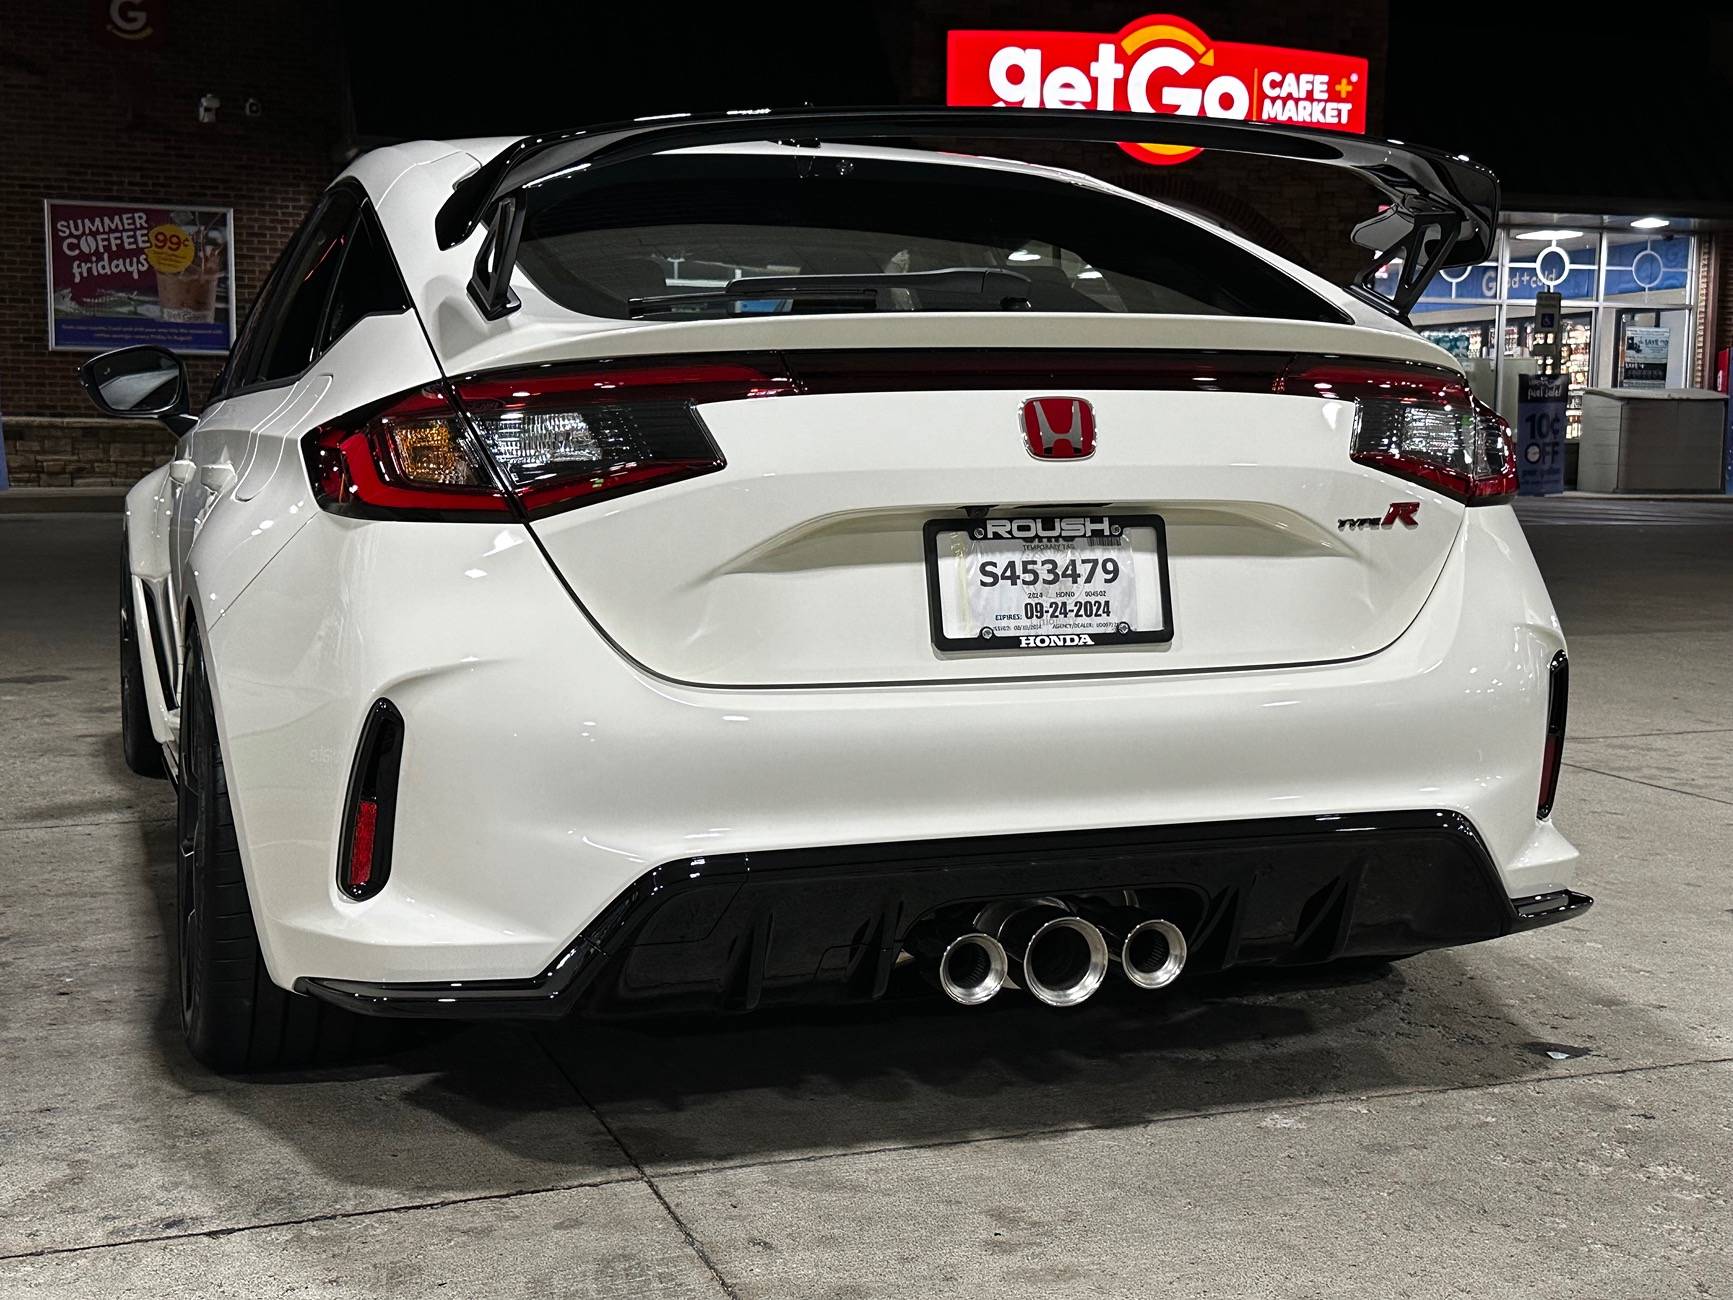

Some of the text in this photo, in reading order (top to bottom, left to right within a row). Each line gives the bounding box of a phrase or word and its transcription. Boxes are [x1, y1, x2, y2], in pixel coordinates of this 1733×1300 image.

[988, 43, 1250, 121] getGo
[1261, 71, 1330, 100] CAFE
[1261, 99, 1353, 125] MARKET
[57, 211, 149, 237] SUMMER
[62, 229, 150, 256] COFFEE
[72, 252, 149, 283] fridays
[1525, 443, 1560, 464] OFF
[986, 516, 1110, 539] ROUSH
[1381, 502, 1421, 531] R
[979, 557, 1120, 588] S453479
[1024, 600, 1111, 620] 09-24-2024
[1019, 634, 1095, 648] HONDA
